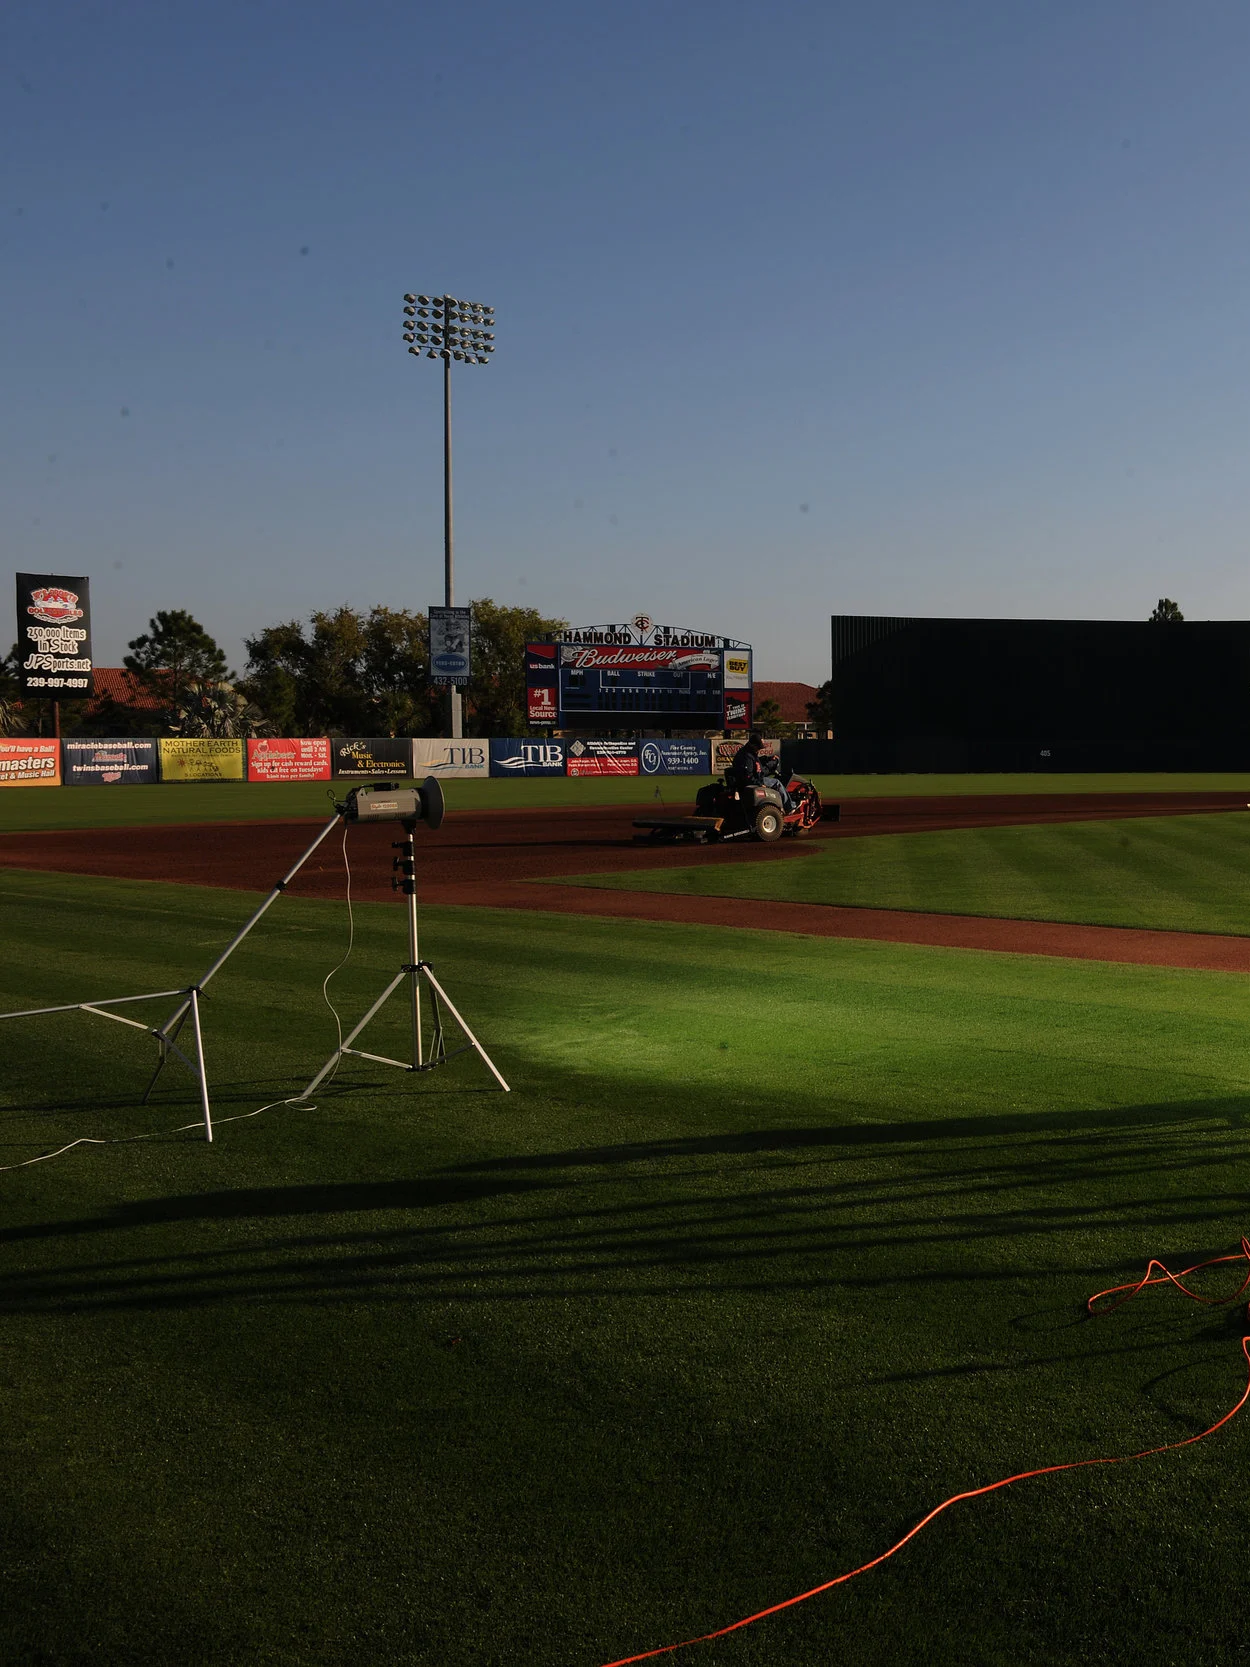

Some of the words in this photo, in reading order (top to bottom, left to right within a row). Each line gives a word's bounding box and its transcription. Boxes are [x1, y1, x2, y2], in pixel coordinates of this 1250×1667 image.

[27, 627, 60, 641] 250,000
[61, 626, 87, 640] Items
[564, 631, 632, 645] HAMMOND
[654, 635, 716, 647] STADIUM
[38, 639, 49, 653] In
[50, 638, 79, 655] Stock
[23, 653, 92, 673] JPSports.net
[572, 648, 678, 669] Budweiser
[26, 677, 89, 688] 239-997-4997
[433, 676, 468, 685] 432-5100
[533, 688, 551, 706] #1
[529, 710, 558, 718] Source
[16, 745, 33, 753] have
[39, 745, 56, 753] Ball!
[67, 742, 152, 750] miraclebaseball.com
[340, 742, 366, 757] Rick's
[351, 751, 373, 759] Music
[444, 747, 484, 764] TIB
[520, 745, 563, 762] TIB
[357, 760, 364, 768] &
[366, 760, 405, 768] Electronics
[667, 757, 699, 765] 939-1400
[72, 764, 149, 772] twinsbaseball.com
[10, 772, 16, 780] &
[17, 771, 40, 779] Music
[40, 769, 55, 777] Hall
